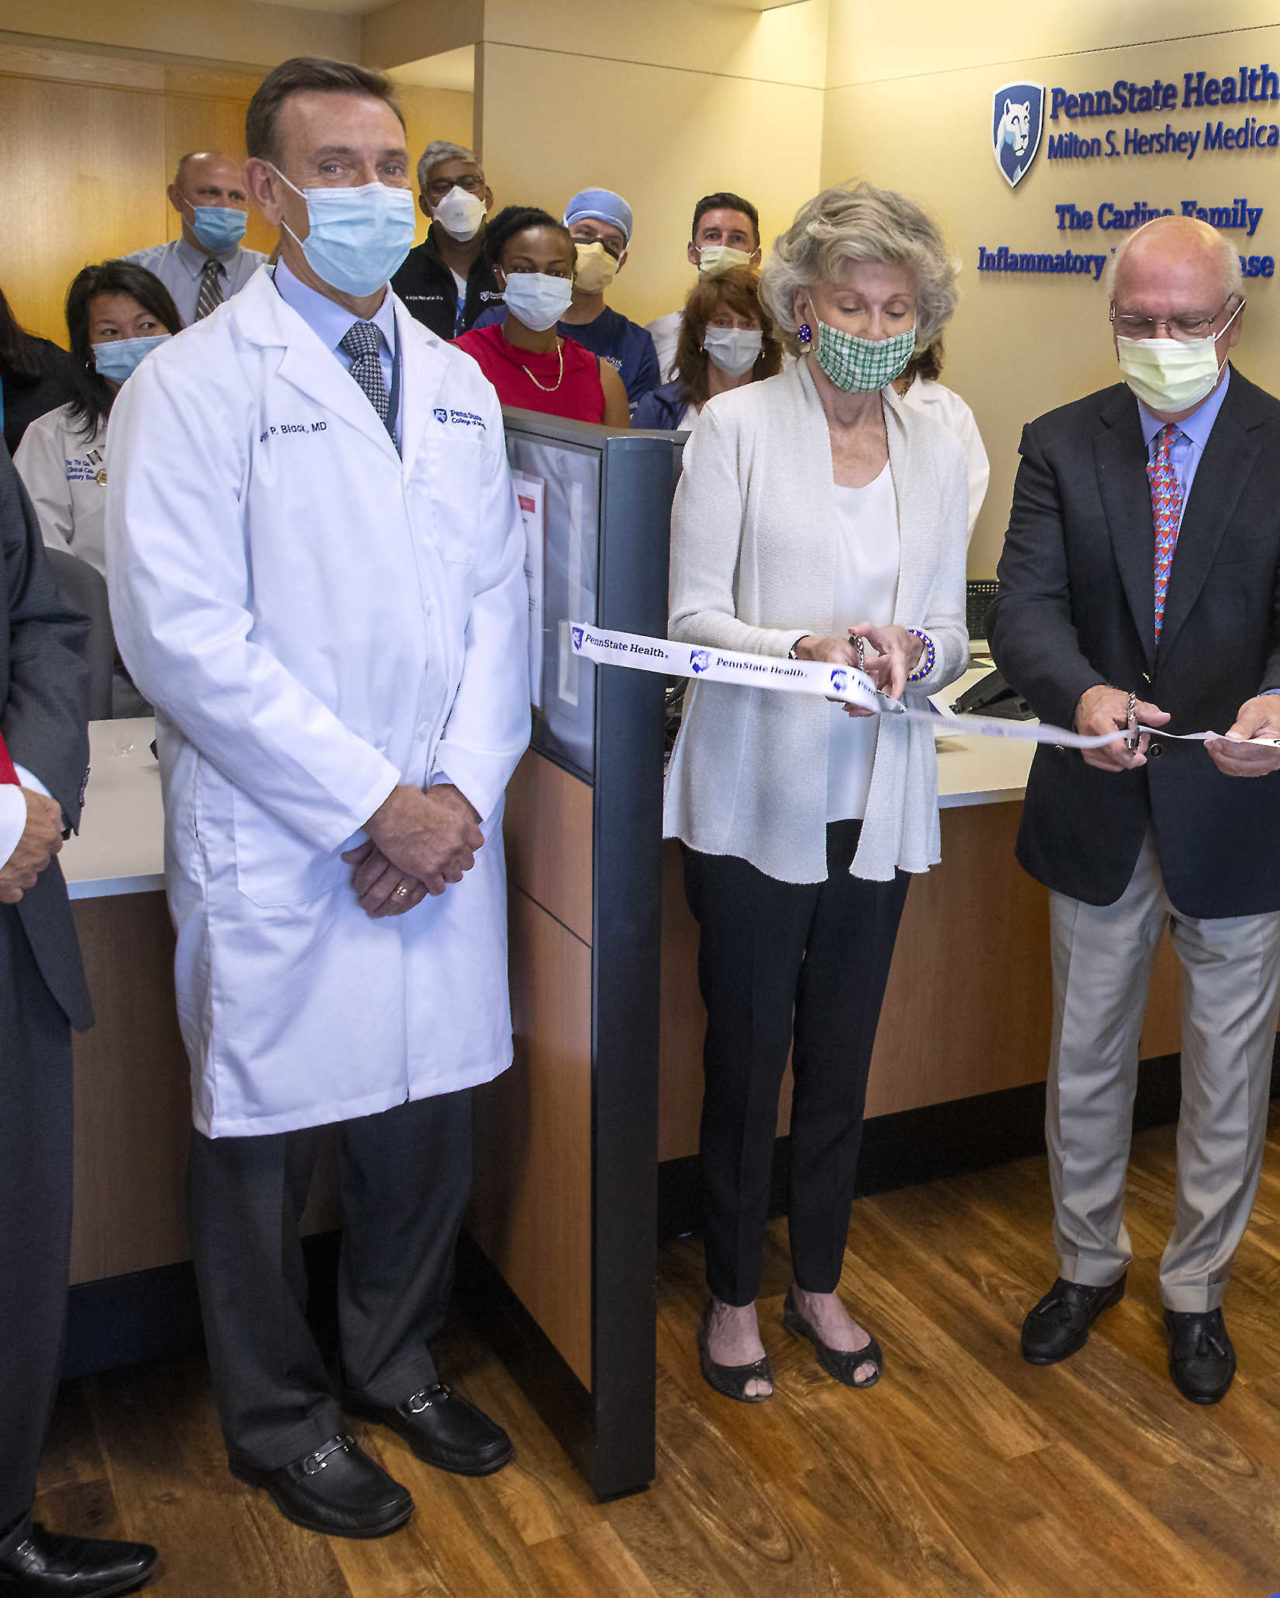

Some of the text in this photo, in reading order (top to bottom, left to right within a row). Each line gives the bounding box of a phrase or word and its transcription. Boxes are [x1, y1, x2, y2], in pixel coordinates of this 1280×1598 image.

[1050, 64, 1280, 119] PennState Health
[1048, 132, 1101, 160] Milton
[1105, 130, 1121, 156] S.
[1124, 125, 1200, 160] Hershey
[1055, 203, 1094, 231] The
[1181, 198, 1264, 237] Family
[977, 246, 1106, 280] Inflammatory
[270, 426, 279, 435] P.
[311, 421, 327, 433] MD
[584, 634, 629, 652] PennState
[716, 657, 769, 673] PennState
